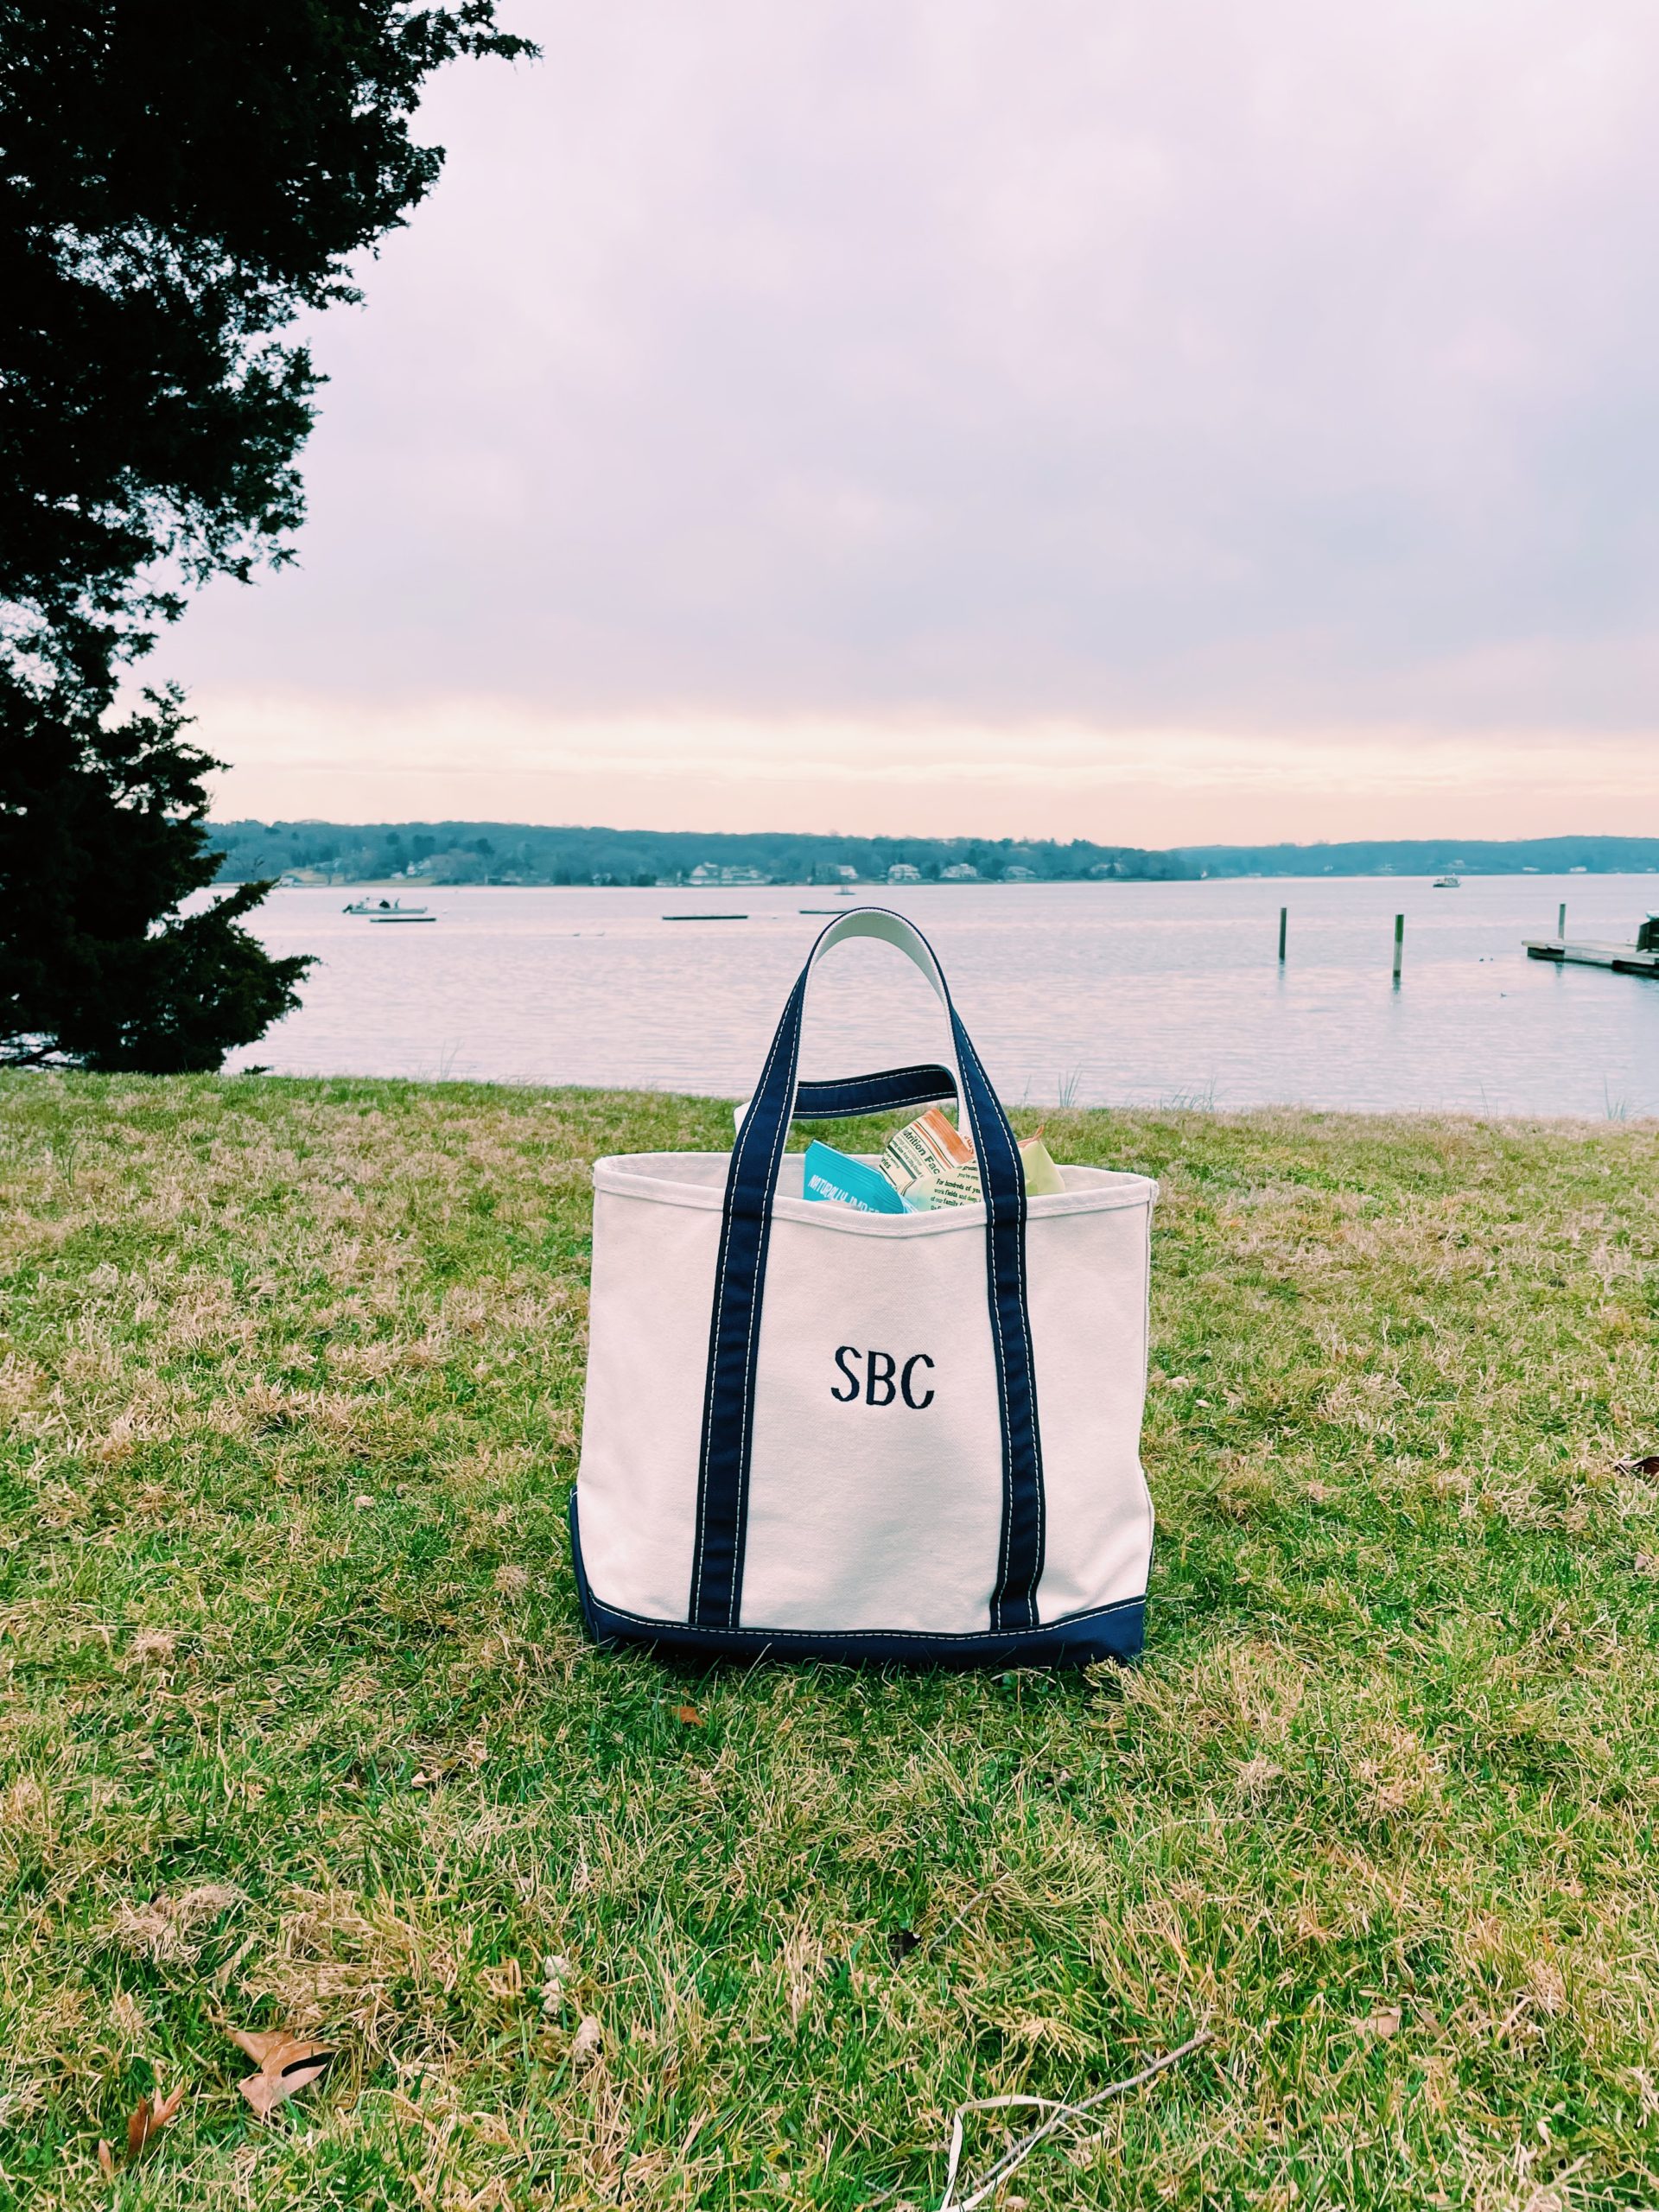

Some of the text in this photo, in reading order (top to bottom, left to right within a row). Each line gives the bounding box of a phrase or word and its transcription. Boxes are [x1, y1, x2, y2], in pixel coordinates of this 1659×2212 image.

[807, 1174, 849, 1201] NATURALLY
[944, 1180, 964, 1190] hundreds
[944, 1189, 957, 1198] fields
[943, 1198, 958, 1206] family
[831, 1345, 934, 1409] SBC
